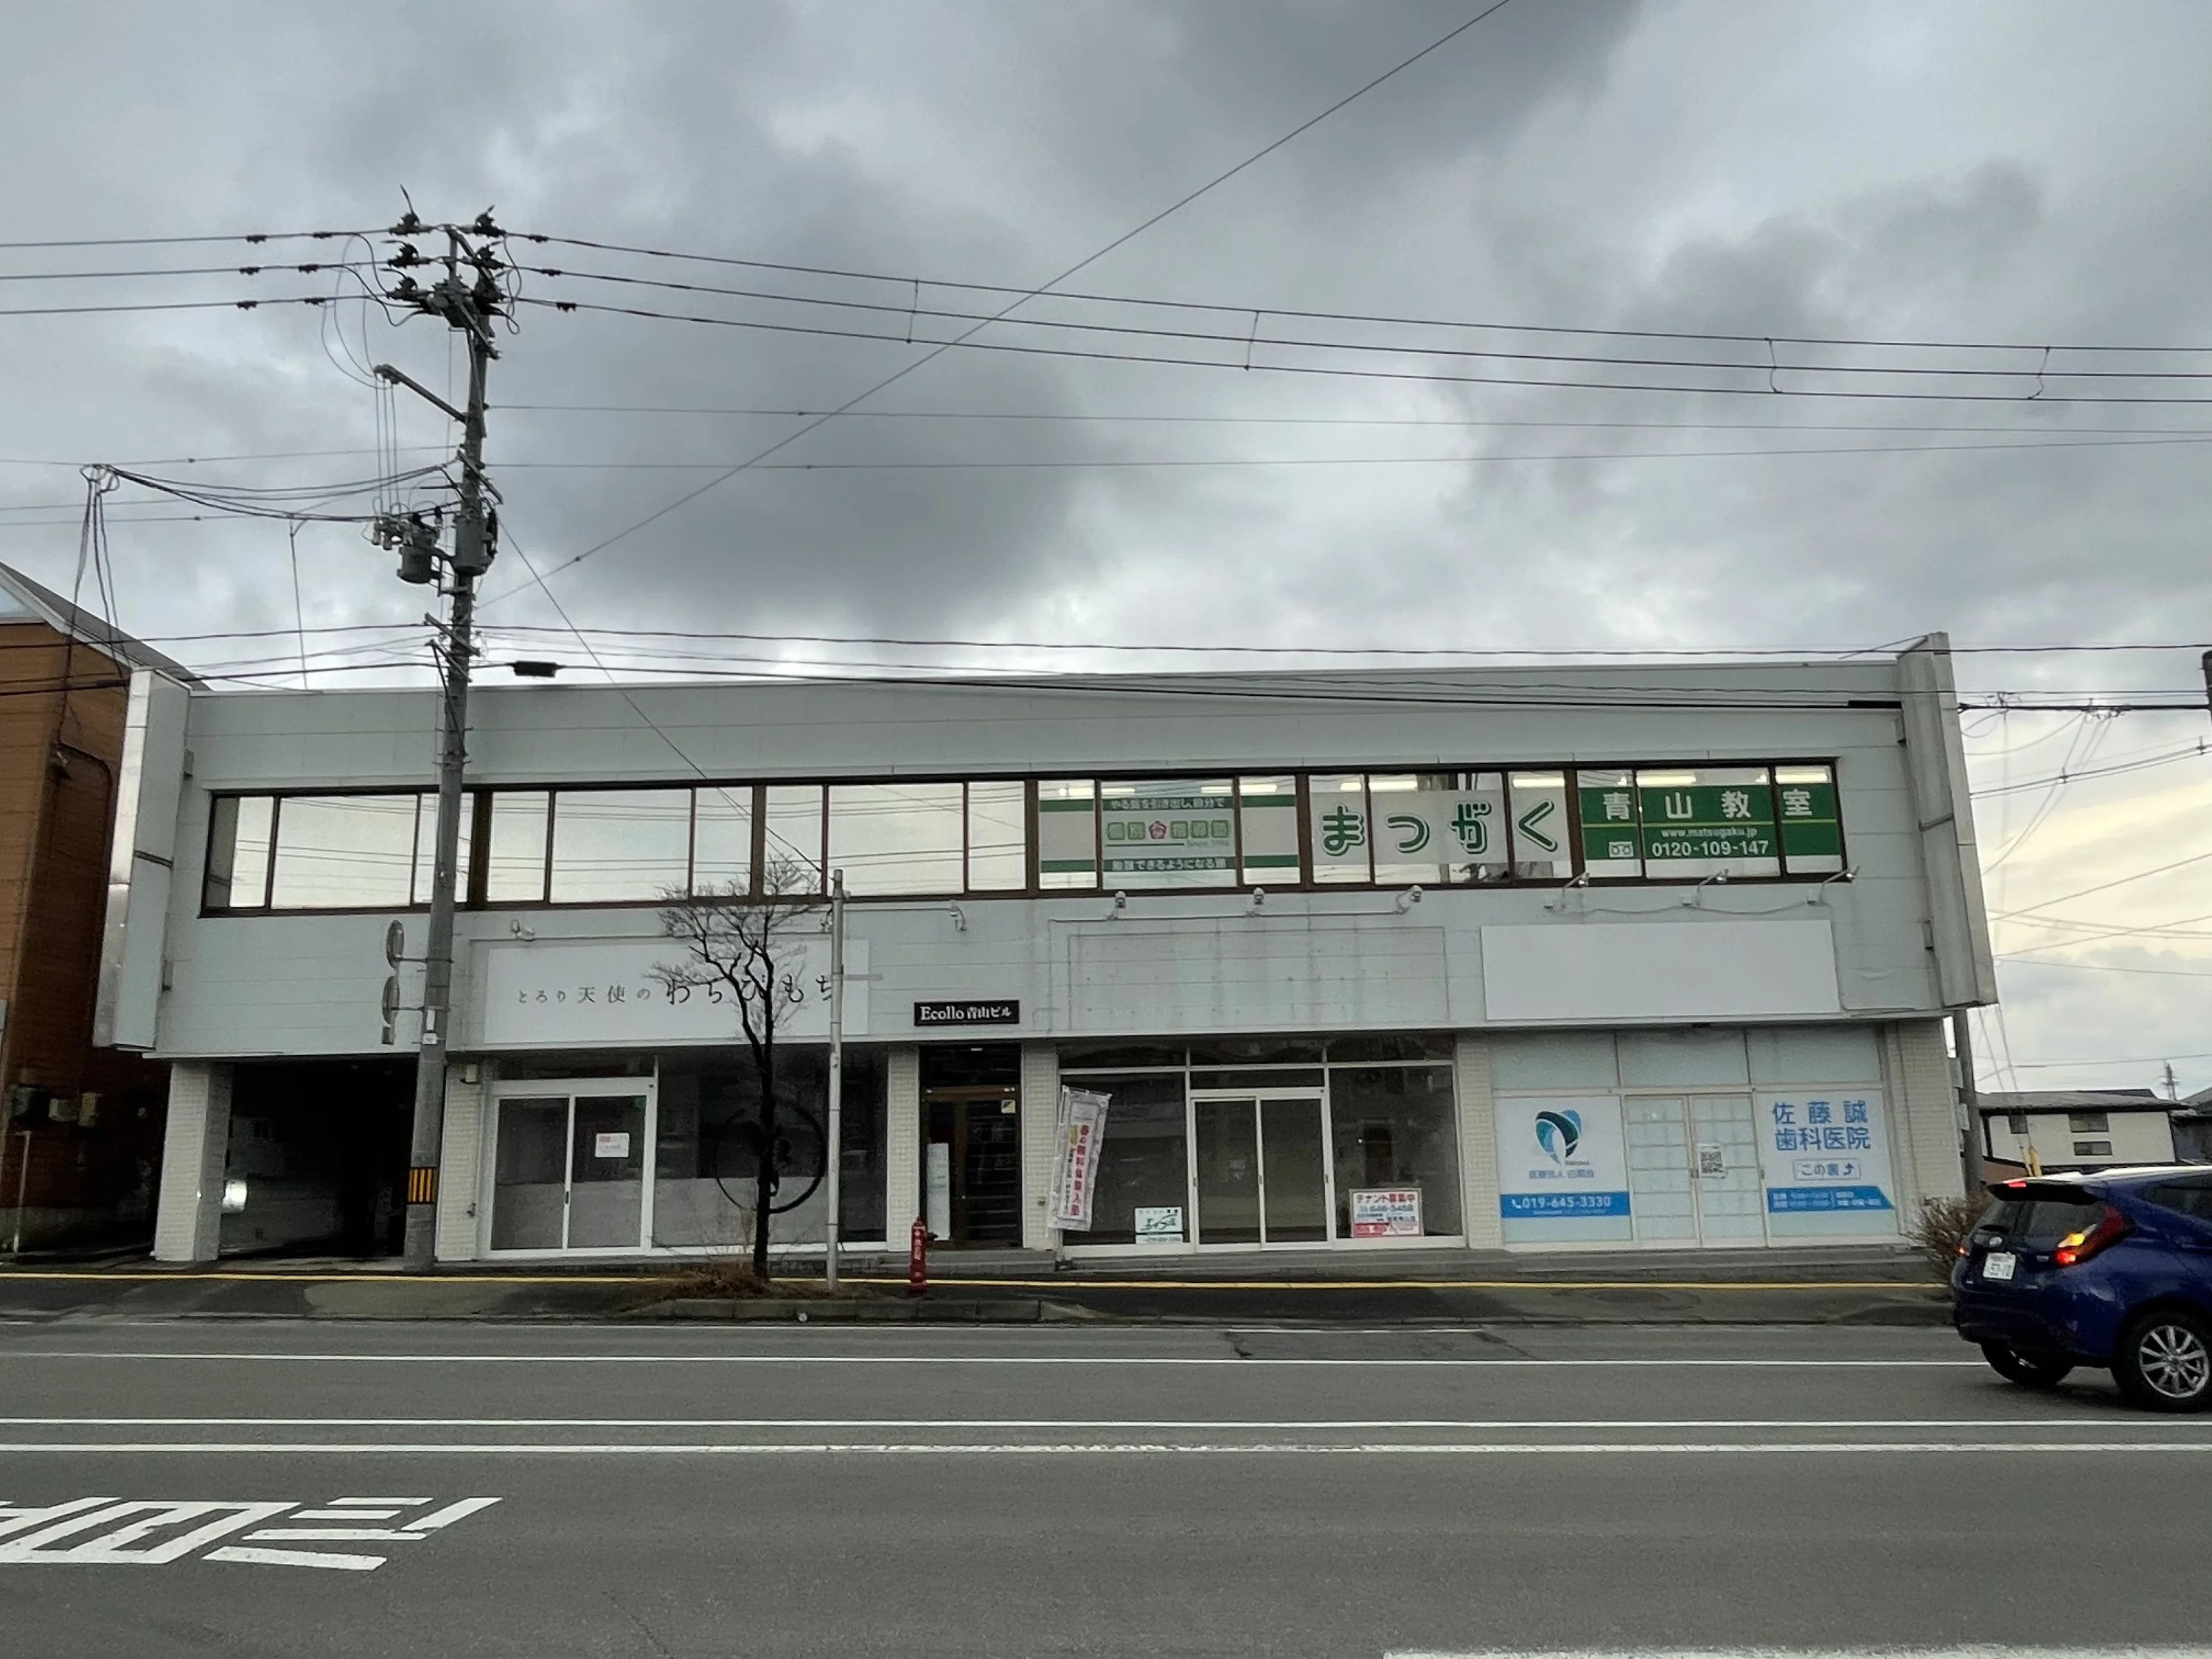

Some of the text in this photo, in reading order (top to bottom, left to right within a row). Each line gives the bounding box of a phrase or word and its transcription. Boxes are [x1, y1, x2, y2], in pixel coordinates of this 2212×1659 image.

[1603, 788, 1812, 821] 青山教室
[1322, 801, 1558, 856] まつがく
[1660, 827, 1758, 838] www.matsugaku.jp
[1652, 840, 1770, 858] 0120-109-147
[920, 1005, 964, 1020] Ecollo
[1772, 1100, 1868, 1125] 佐藤誠
[1774, 1127, 1871, 1151] 歯科医院
